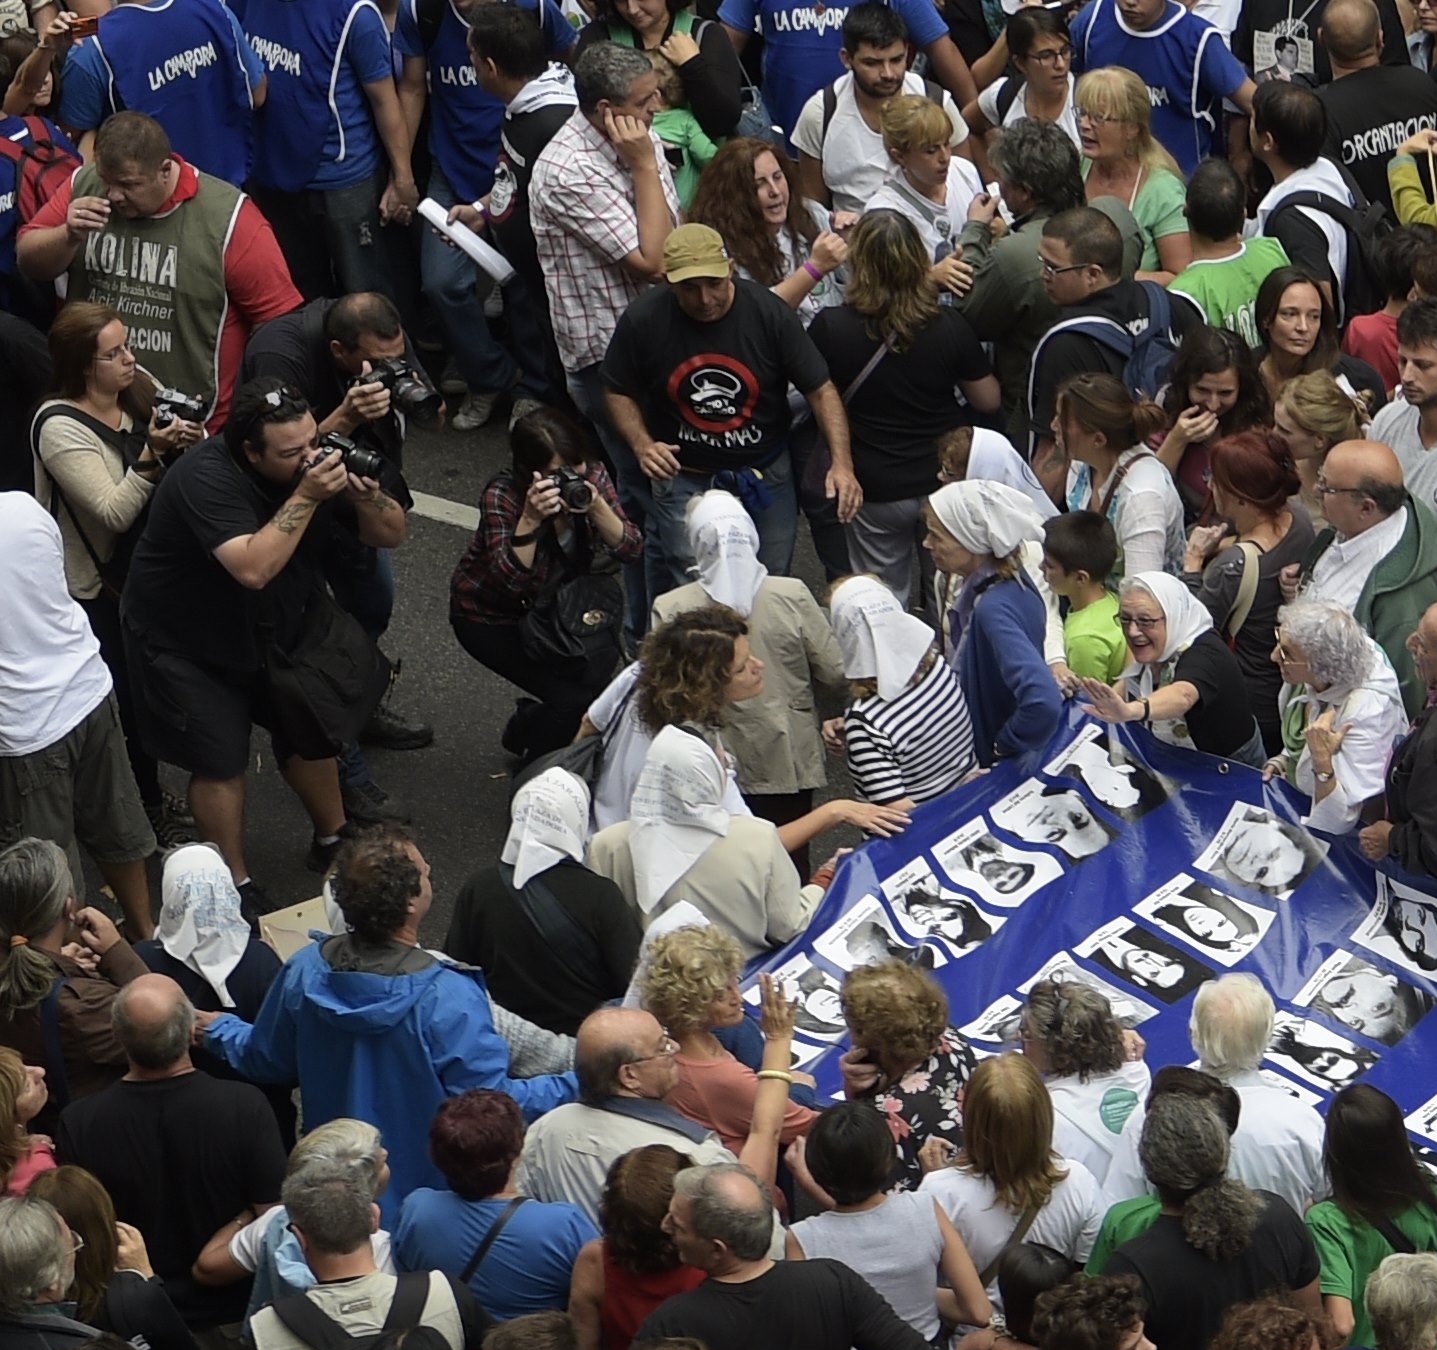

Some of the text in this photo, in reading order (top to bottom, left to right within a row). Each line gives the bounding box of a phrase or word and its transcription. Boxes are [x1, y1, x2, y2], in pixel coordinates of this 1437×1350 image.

[774, 11, 791, 31] LA
[148, 71, 166, 91] LA
[440, 67, 457, 85] LA
[85, 231, 177, 288] KOLINA
[117, 296, 175, 320] Kirchner
